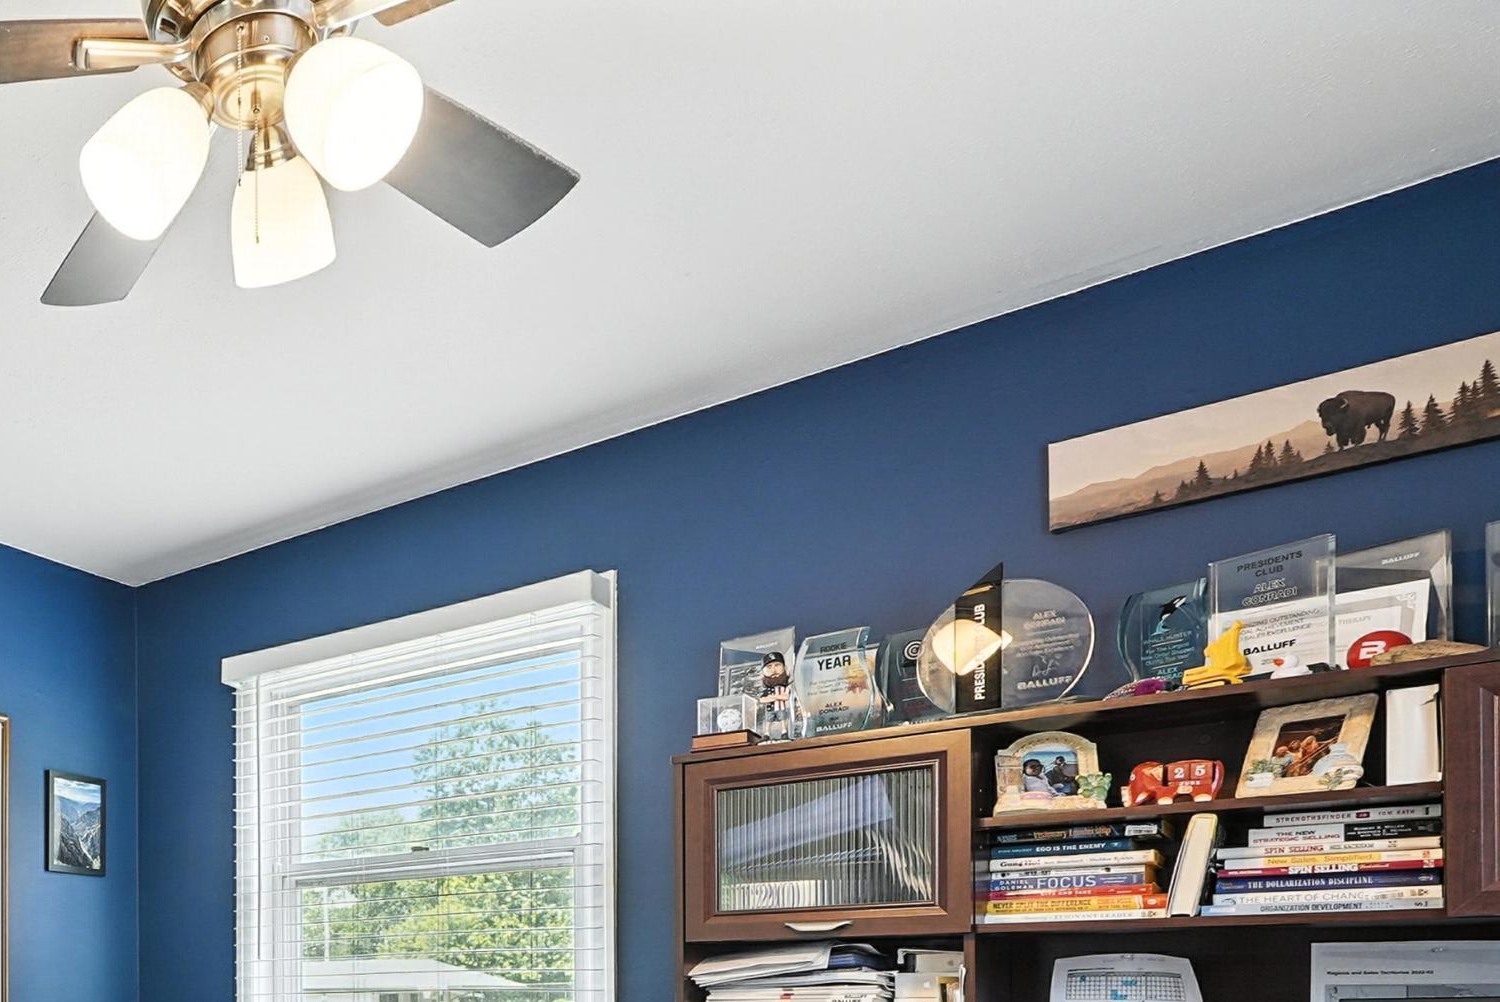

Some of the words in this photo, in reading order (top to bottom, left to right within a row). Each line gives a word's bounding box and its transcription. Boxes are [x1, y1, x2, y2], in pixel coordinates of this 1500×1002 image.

[1237, 550, 1303, 572] PRESIDENTS
[1255, 565, 1284, 577] CLUB
[1254, 577, 1286, 593] ALEX
[1243, 639, 1297, 656] BALLUFF
[817, 655, 852, 671] YEAR
[1174, 767, 1185, 779] 2
[1195, 764, 1206, 776] 5
[1036, 845, 1052, 853] EGO
[1079, 842, 1106, 850] ENEMY
[1264, 847, 1285, 855] SPIN
[1288, 865, 1313, 875] SPIN
[1313, 863, 1359, 874] SELLING
[1037, 875, 1097, 889] FOCUS
[1247, 881, 1263, 889] THE
[1265, 878, 1326, 889] DOLLARIZATION
[1328, 876, 1374, 886] DISCIPLINE
[1240, 896, 1259, 904] THE
[1263, 894, 1300, 904] HEART
[1304, 893, 1317, 901] OF
[1260, 903, 1310, 912] ORGANIZATION
[1311, 902, 1362, 911] DEVELOPMENT
